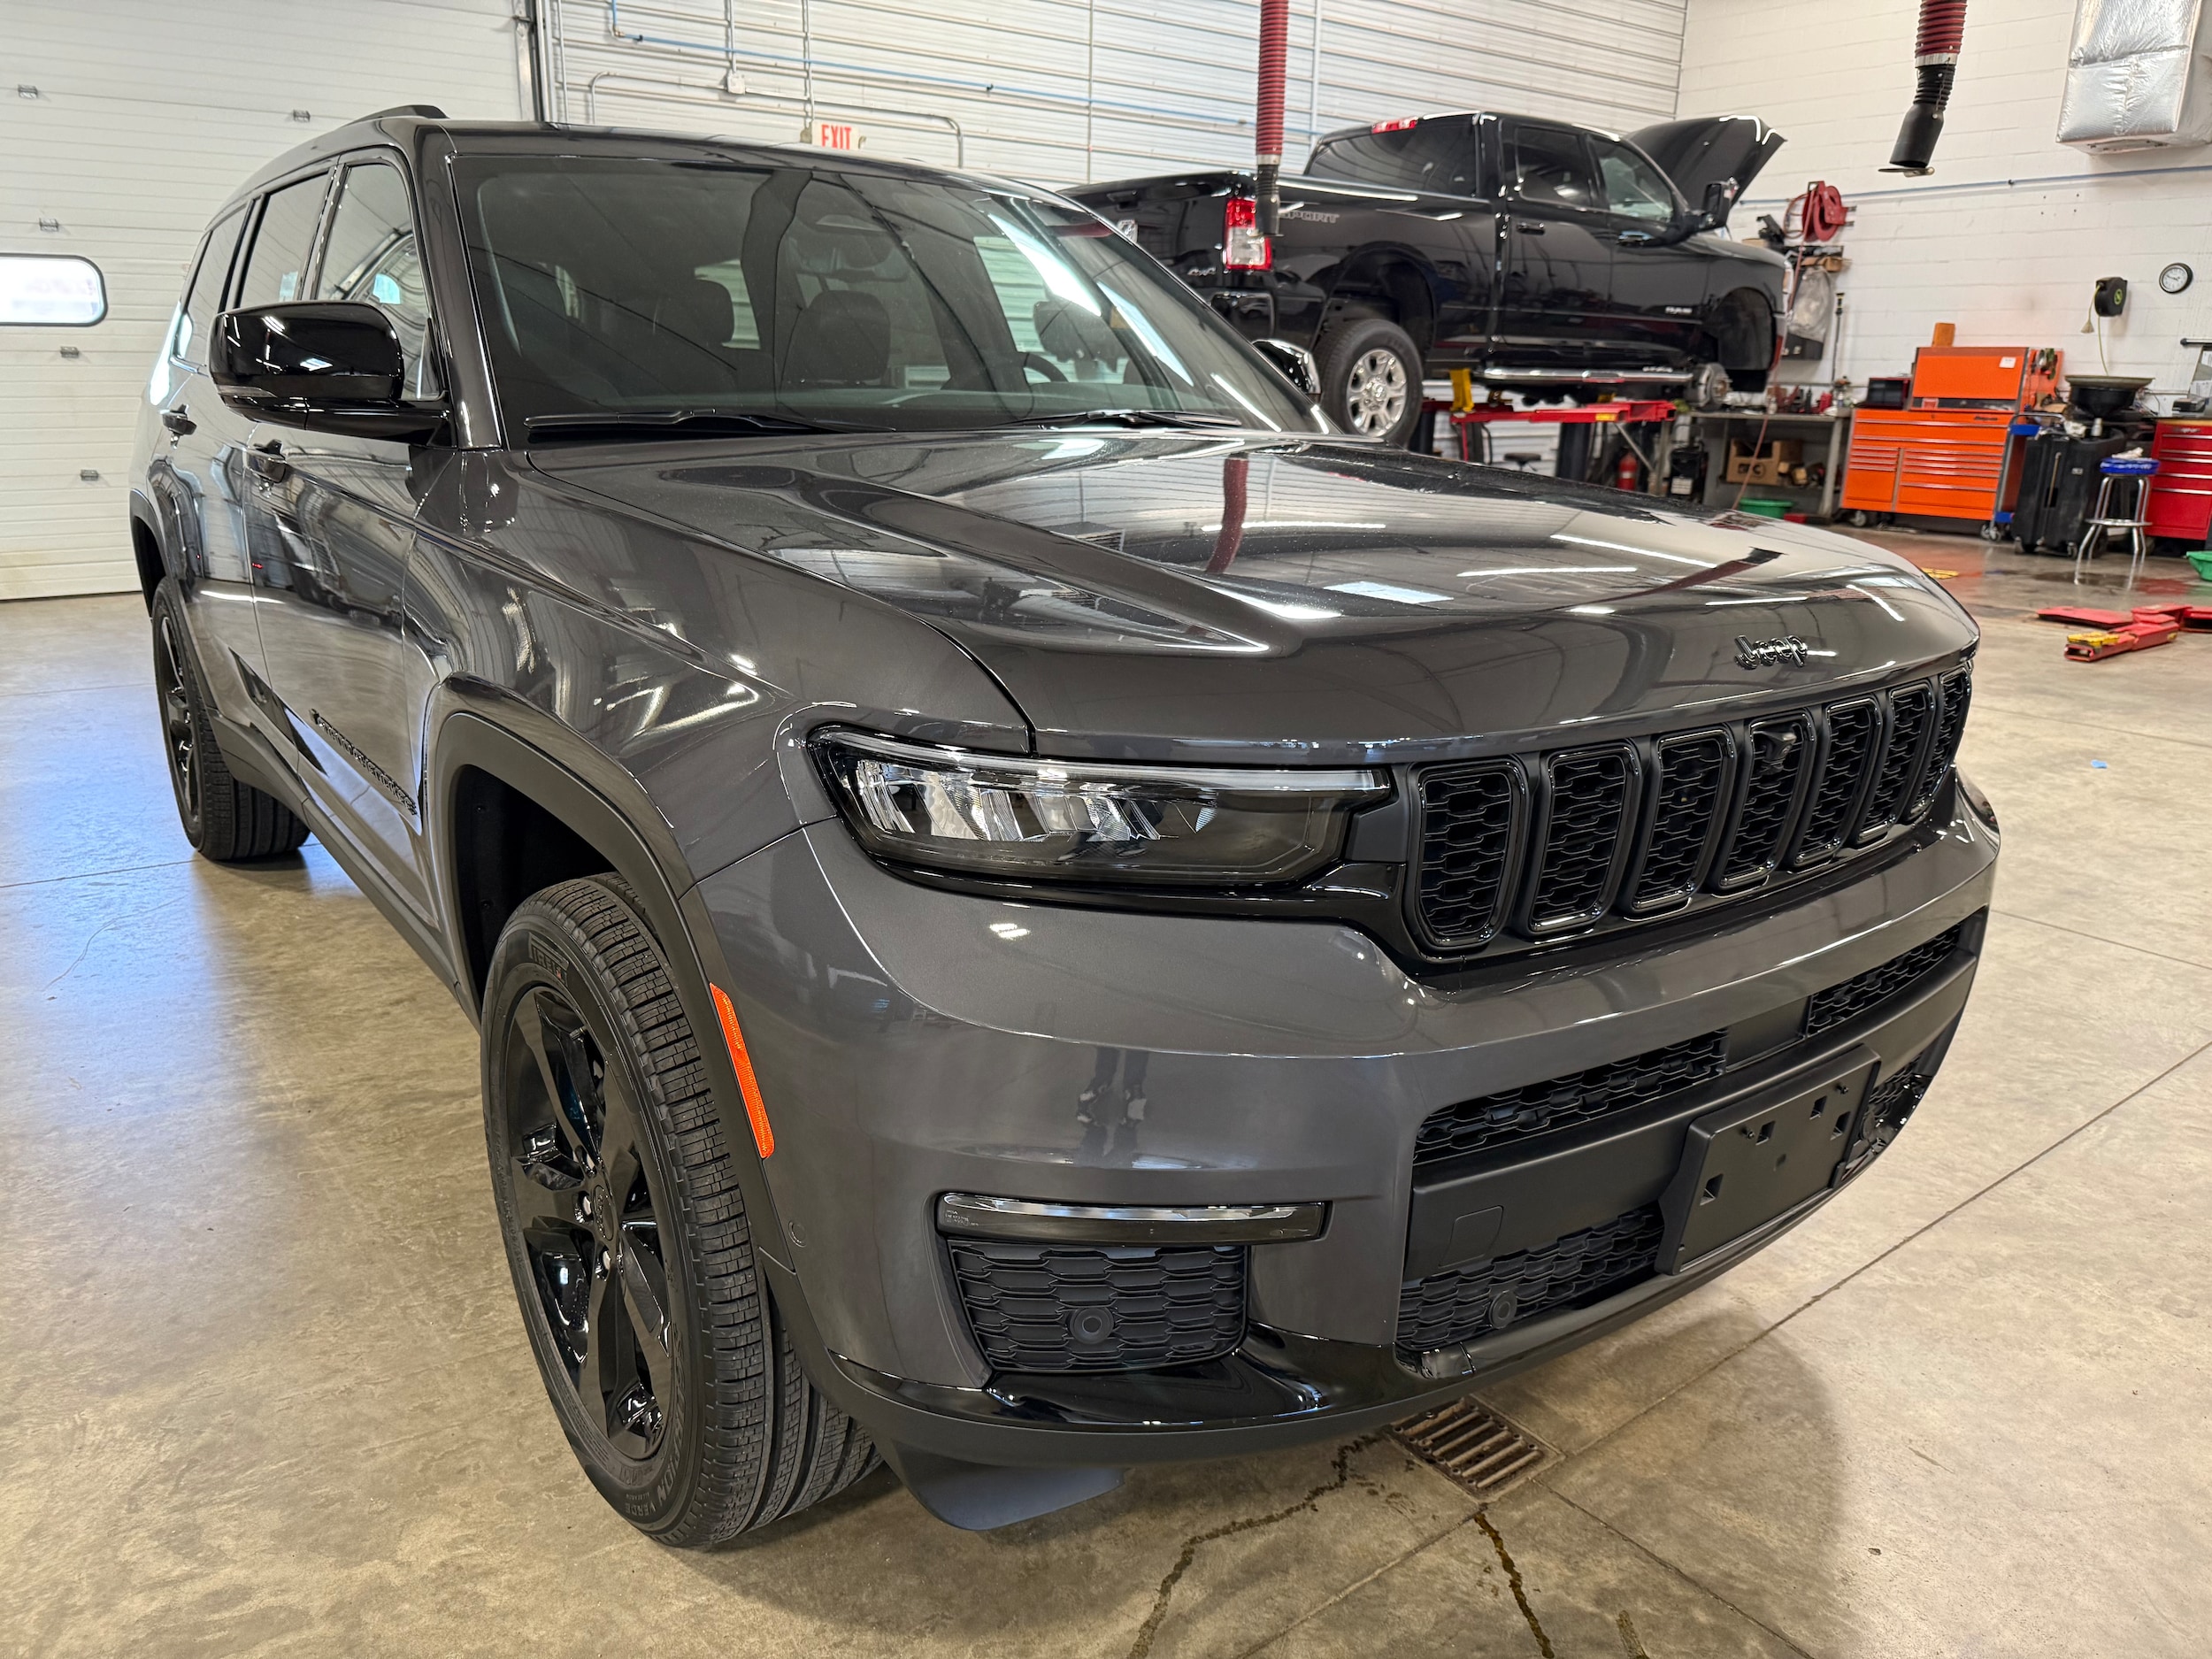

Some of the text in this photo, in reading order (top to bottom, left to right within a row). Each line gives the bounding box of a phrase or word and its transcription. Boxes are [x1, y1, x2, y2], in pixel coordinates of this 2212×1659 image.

[822, 124, 852, 150] EXIT
[1734, 634, 1808, 670] Jeep
[625, 1501, 657, 1517] VERDE
